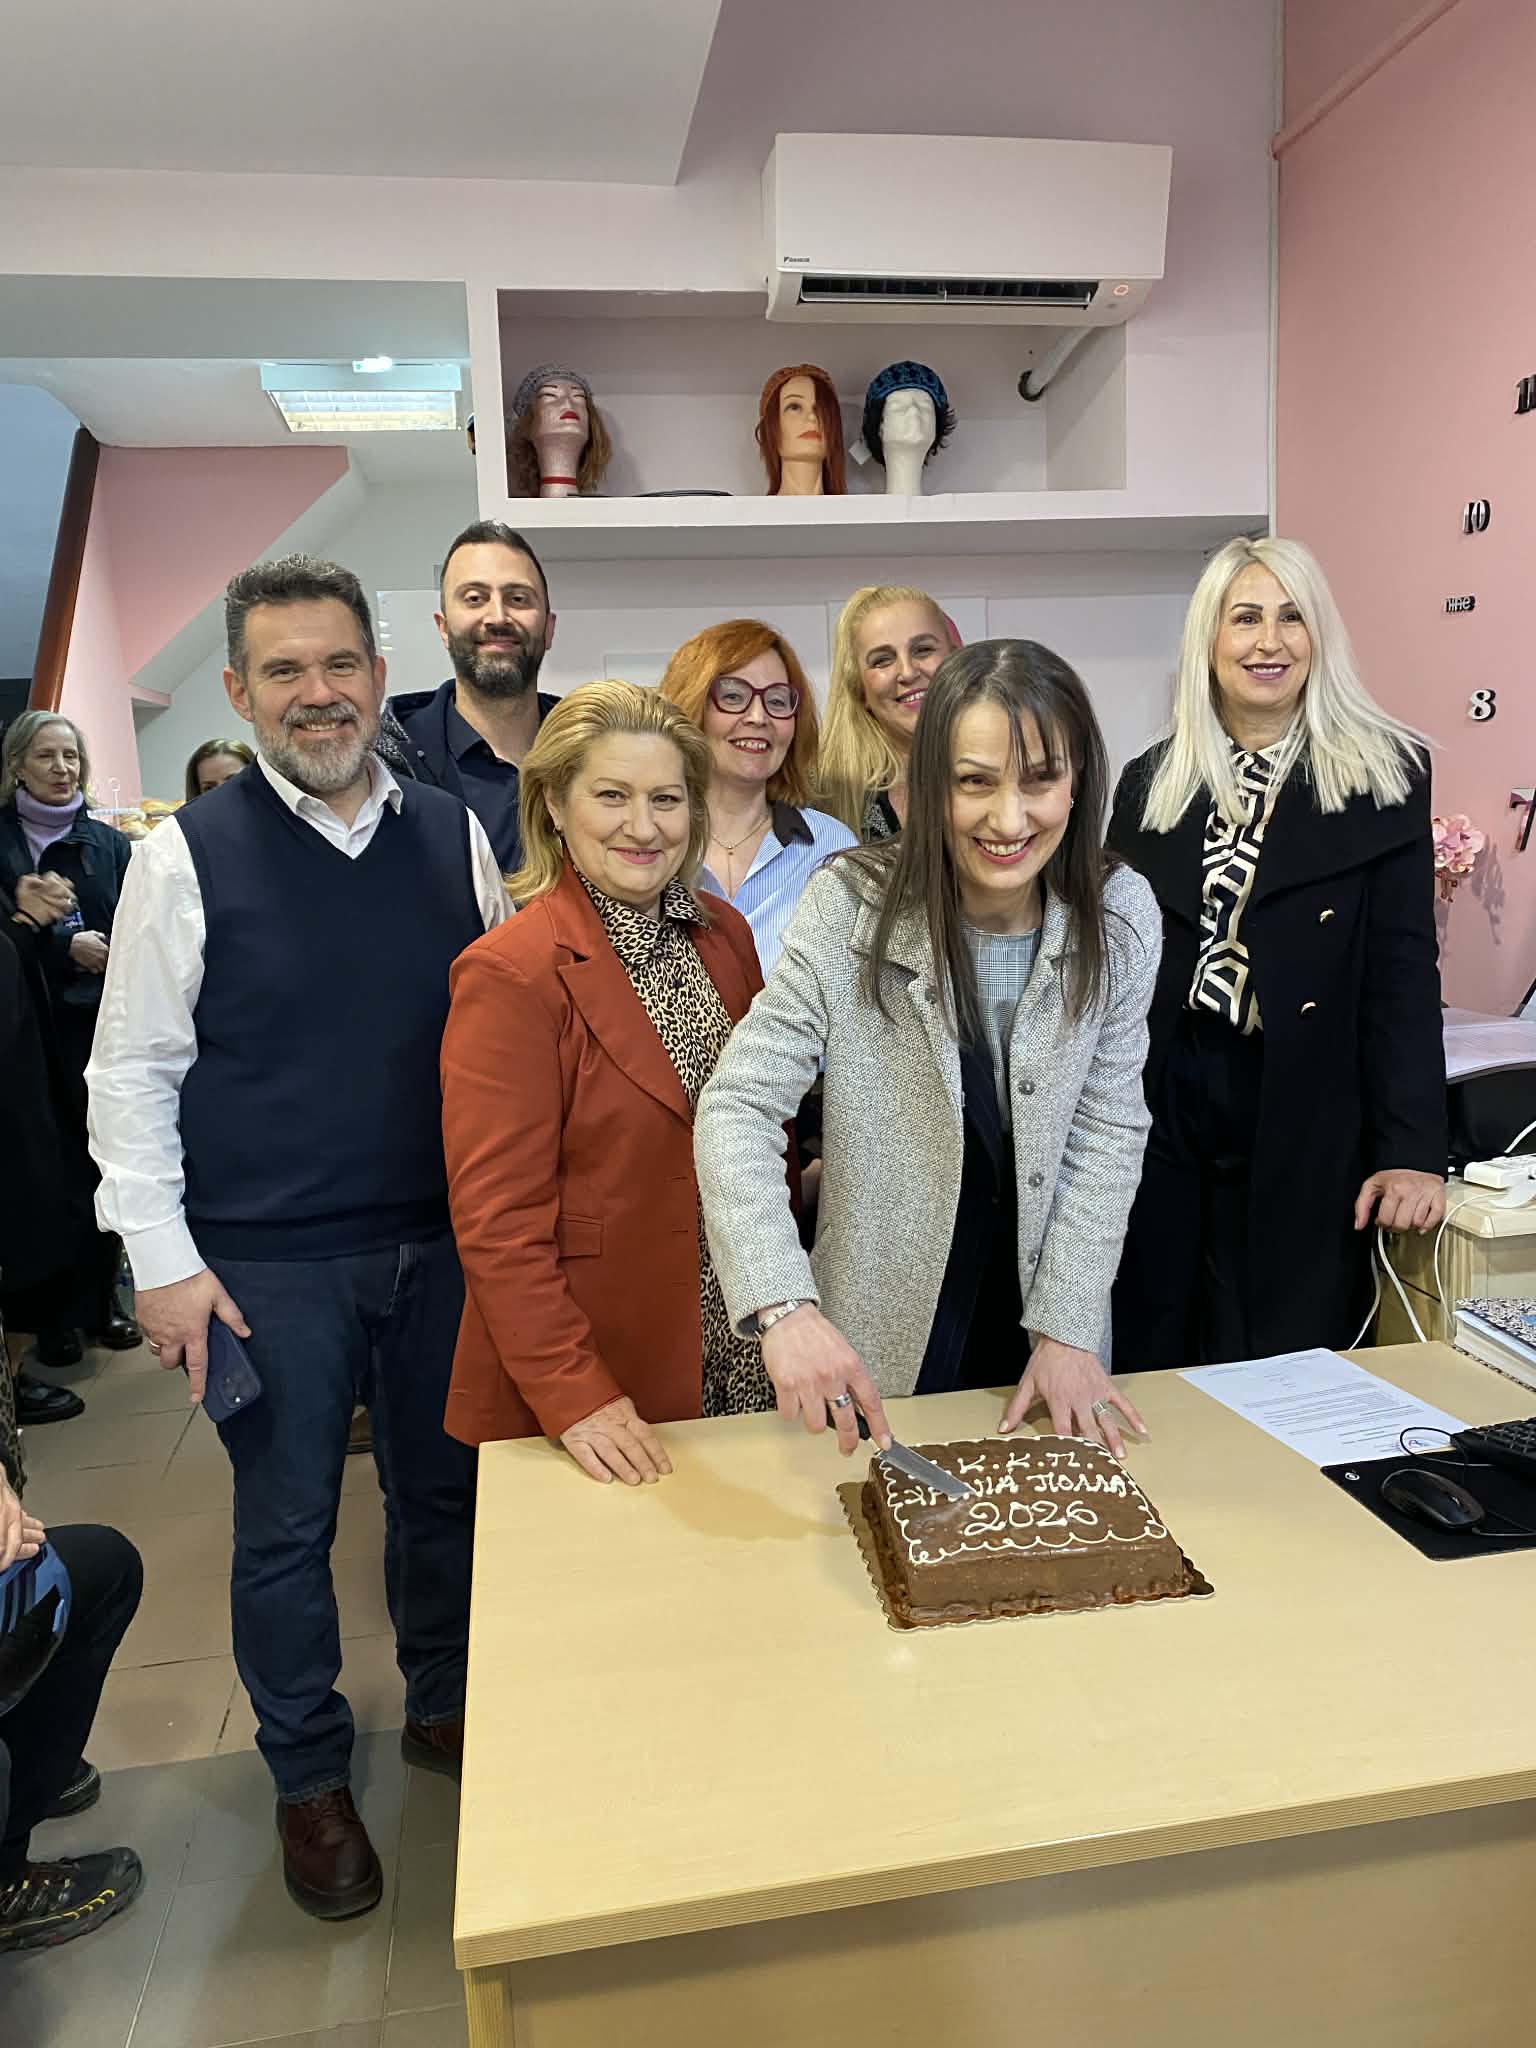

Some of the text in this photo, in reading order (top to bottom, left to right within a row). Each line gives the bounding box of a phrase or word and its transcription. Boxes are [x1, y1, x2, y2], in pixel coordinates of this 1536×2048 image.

[1463, 499, 1491, 535] 10
[1467, 688, 1496, 722] 8
[964, 1500, 1099, 1537] 2026
